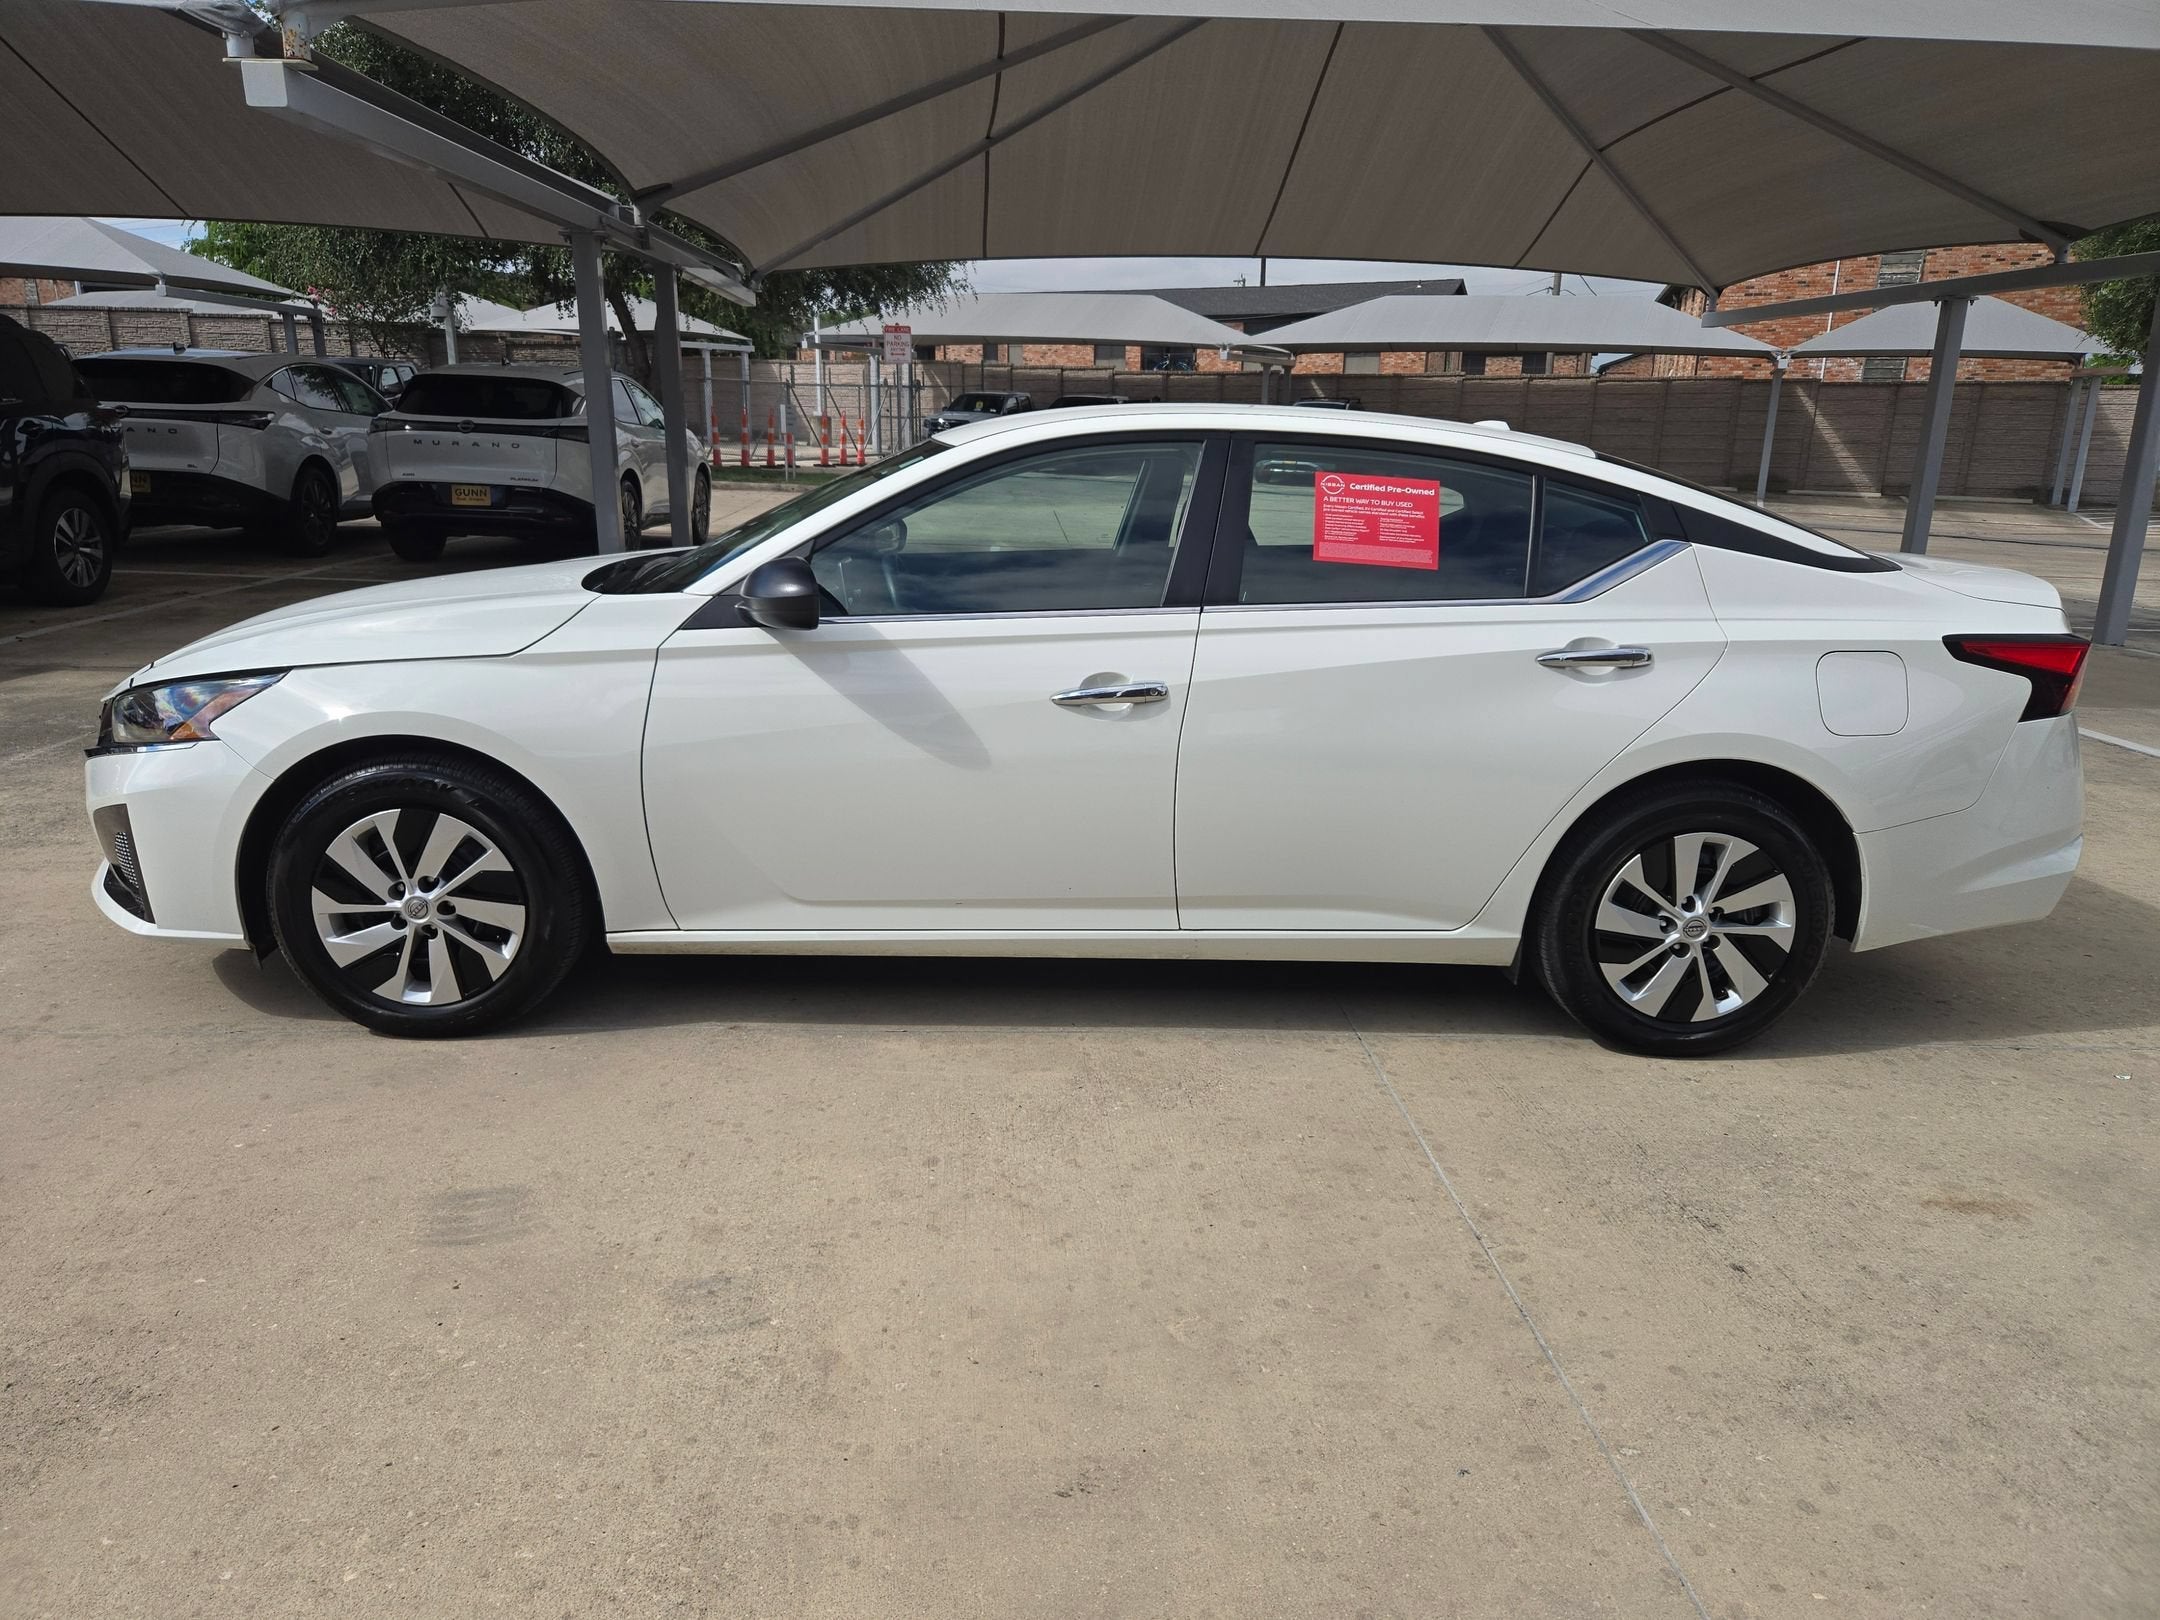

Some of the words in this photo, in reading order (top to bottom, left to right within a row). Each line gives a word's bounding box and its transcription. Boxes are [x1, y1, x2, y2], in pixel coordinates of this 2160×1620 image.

[413, 439, 520, 449] MURANO
[455, 488, 487, 497] GUNN
[1349, 482, 1386, 492] Certified
[1387, 486, 1435, 496] Pre-Owned
